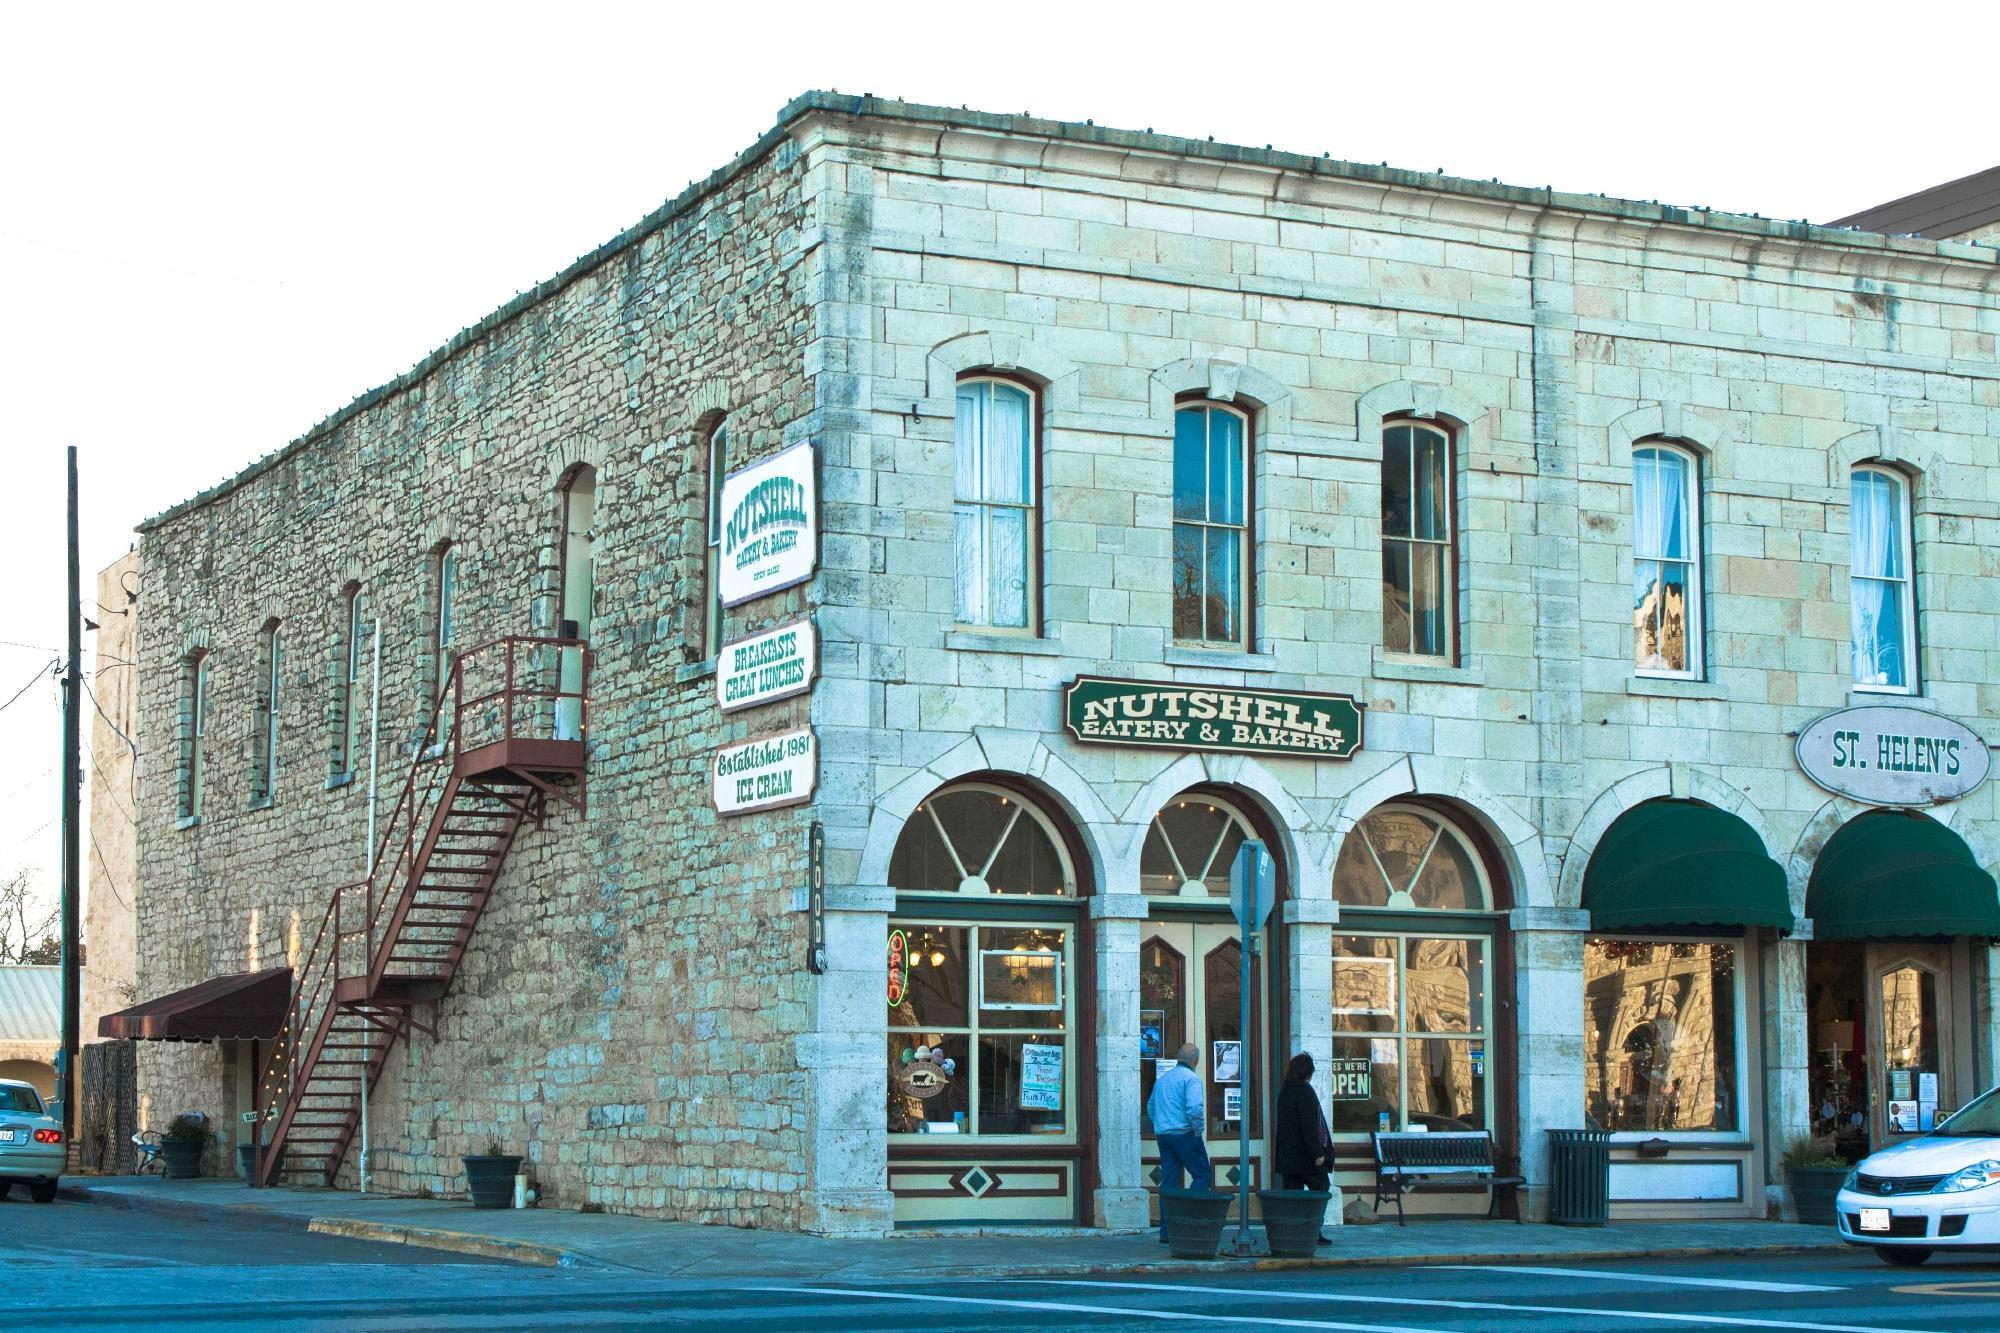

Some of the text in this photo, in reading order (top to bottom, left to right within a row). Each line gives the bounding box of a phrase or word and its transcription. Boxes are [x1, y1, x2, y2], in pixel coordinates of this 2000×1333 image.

[726, 476, 808, 556] NUTSHELL
[736, 529, 799, 571] EATERY & BAKERY
[753, 568, 766, 581] OPEN
[734, 631, 797, 673] BREAKFASTS
[725, 657, 805, 702] GREAT LUNCHES
[1081, 720, 1345, 751] EATERY & BAKERY
[1083, 690, 1343, 739] NUTSHELL
[717, 733, 810, 777] Established 1981
[1832, 730, 1960, 776] ST. HELEN'S
[736, 769, 793, 804] ICE CREAM
[1344, 1062, 1367, 1071] WE'RE
